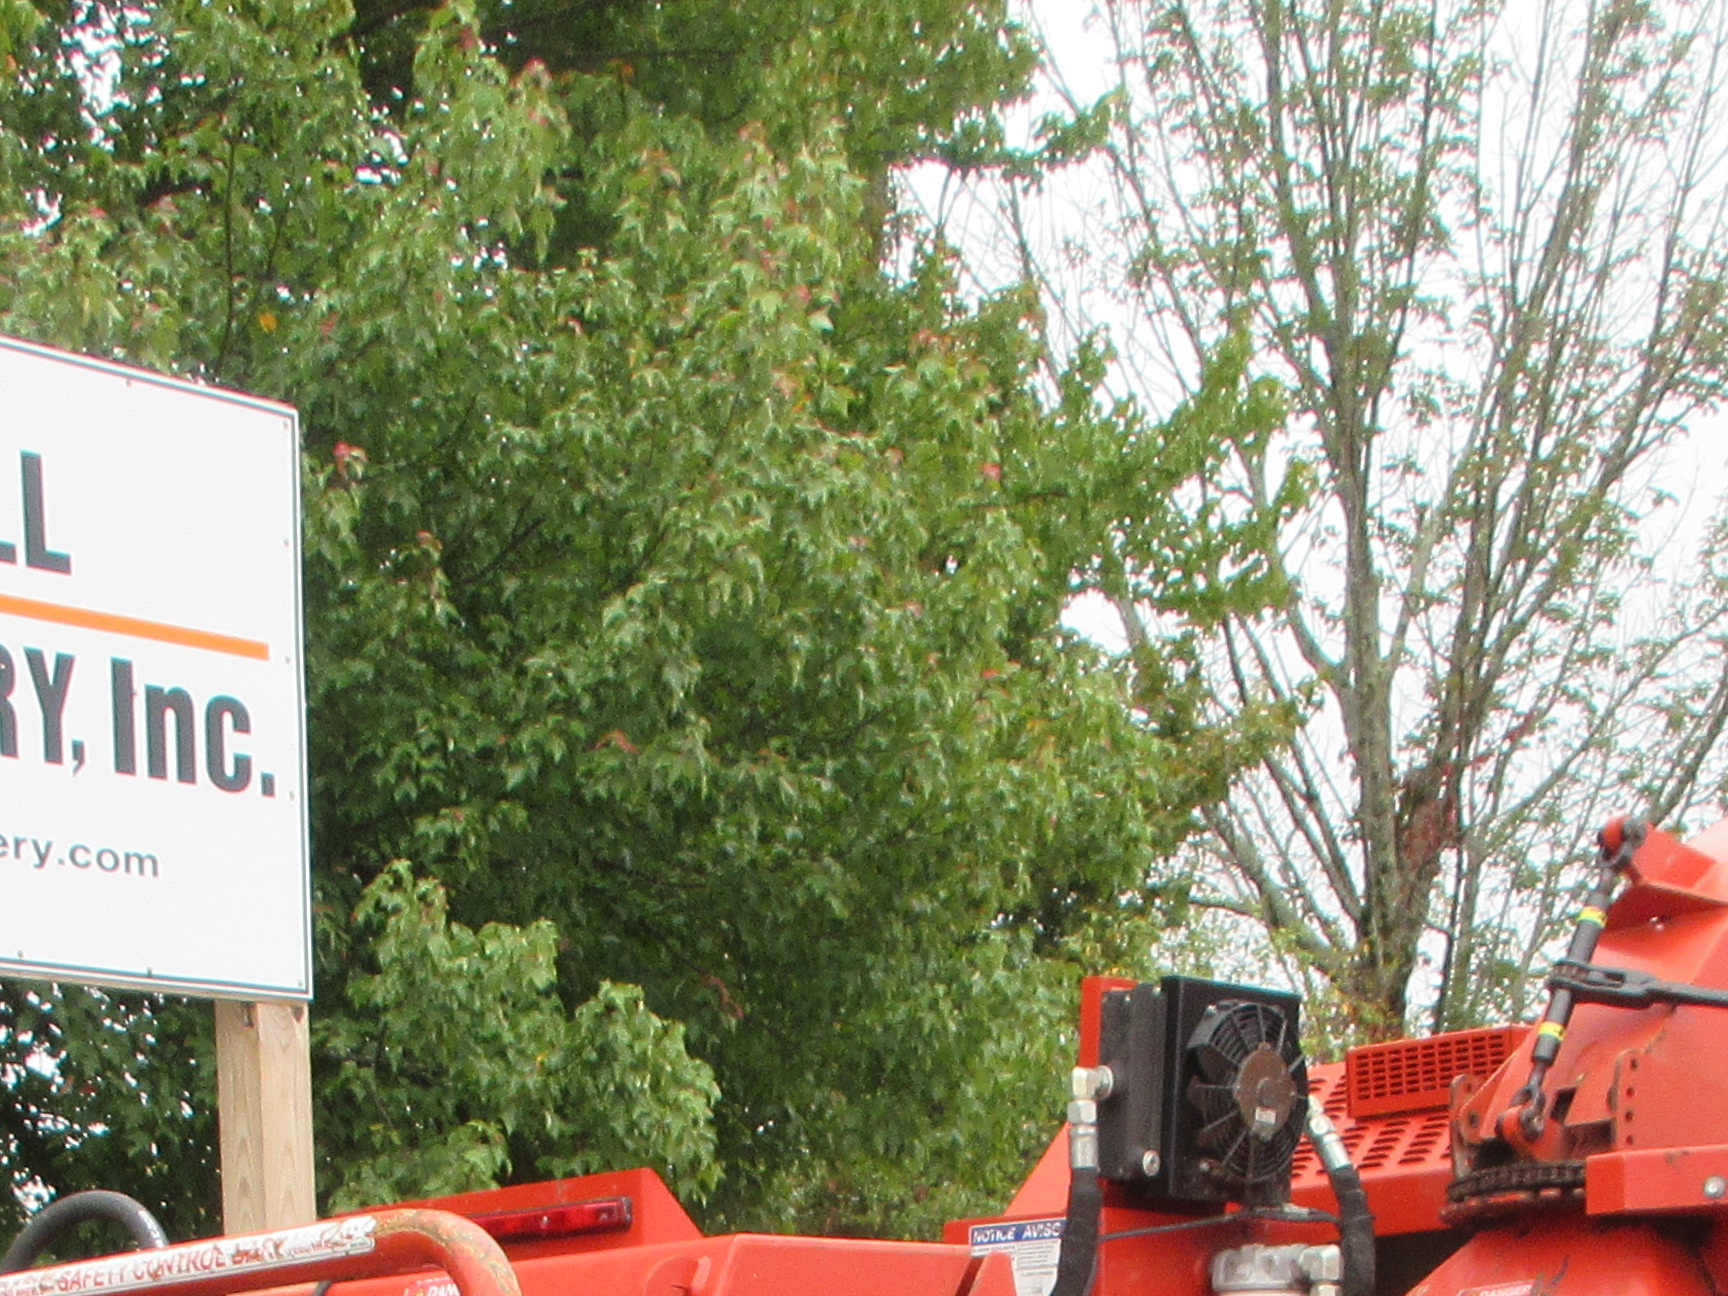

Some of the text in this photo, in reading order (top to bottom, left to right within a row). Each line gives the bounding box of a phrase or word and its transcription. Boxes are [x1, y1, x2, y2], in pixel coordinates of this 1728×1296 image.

[111, 658, 277, 799] Inc.
[973, 1227, 1016, 1243] NOTICE
[57, 1267, 126, 1292] SAFETY
